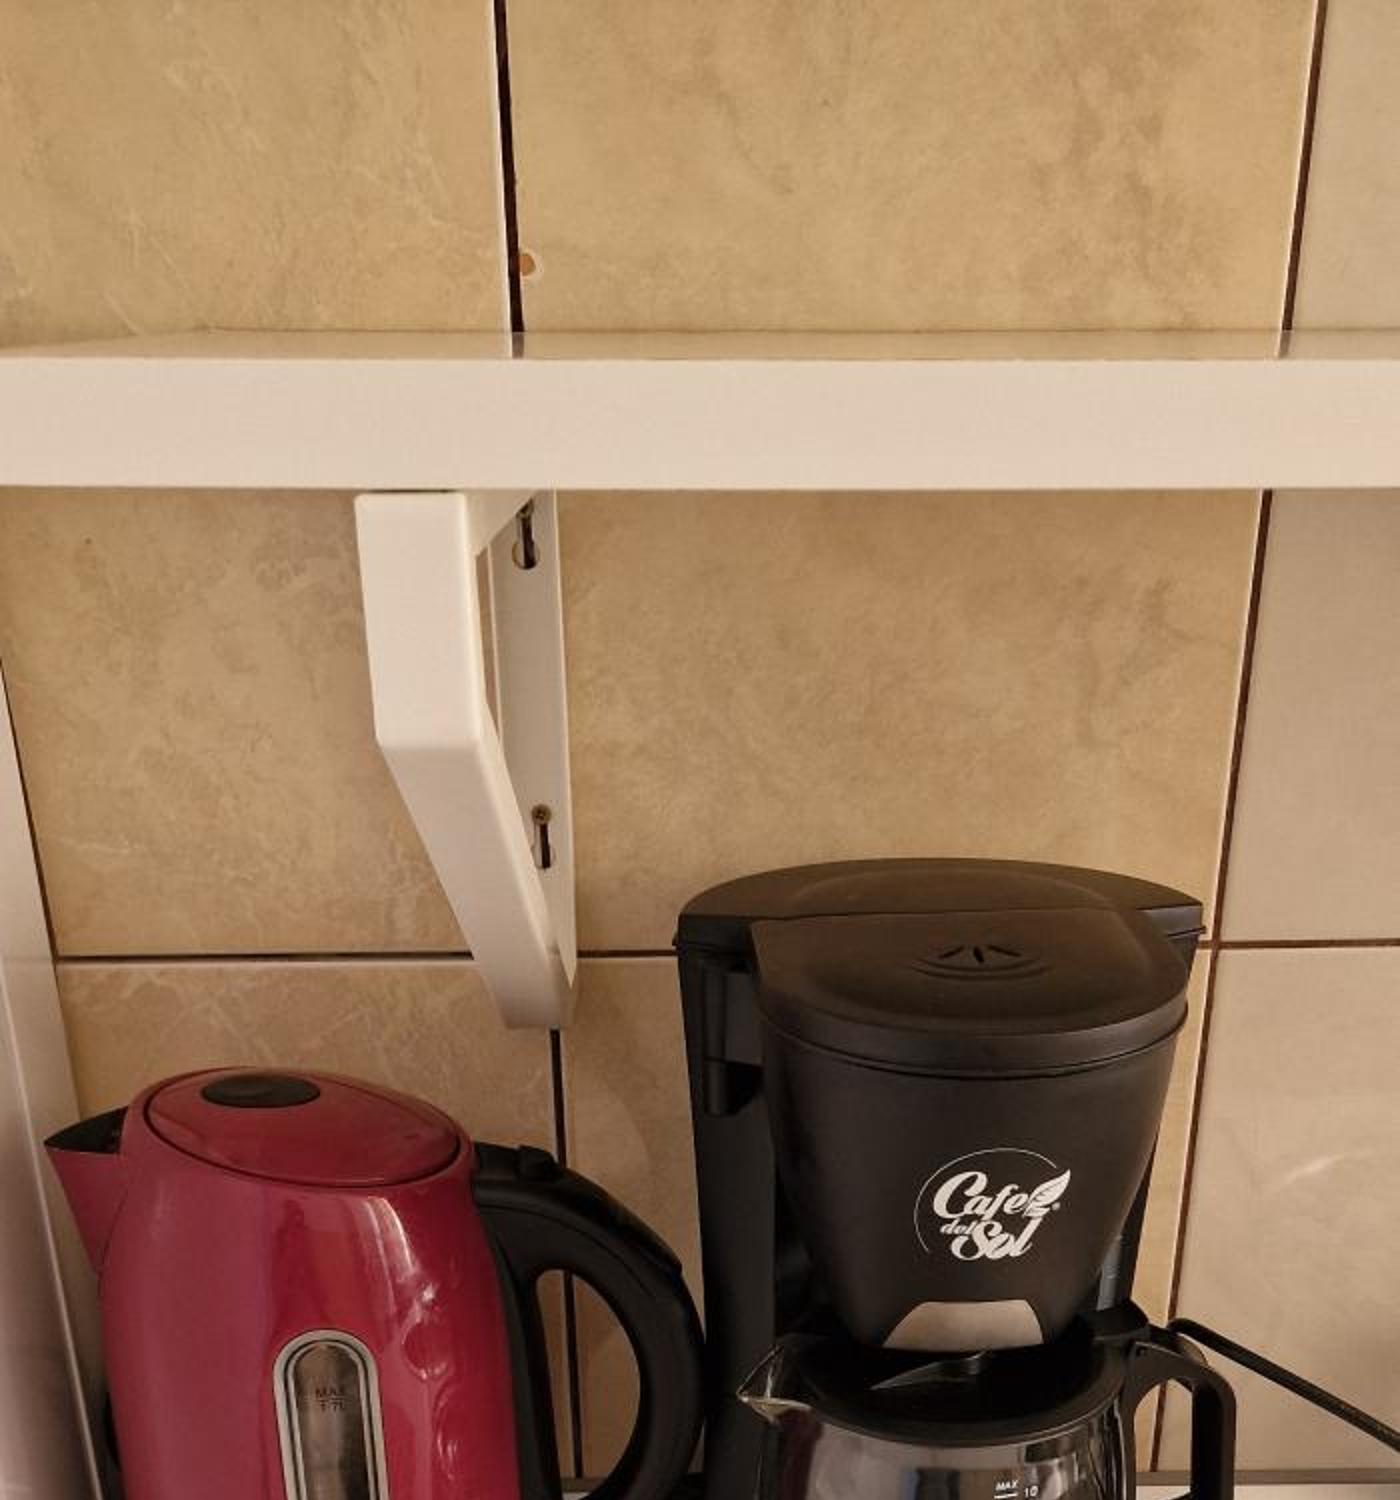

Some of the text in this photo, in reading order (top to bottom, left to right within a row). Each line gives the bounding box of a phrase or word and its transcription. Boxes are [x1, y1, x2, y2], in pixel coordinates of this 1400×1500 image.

[933, 1171, 1031, 1221] Cafe
[951, 1216, 1043, 1261] Sol
[995, 1479, 1039, 1498] MAX 10
